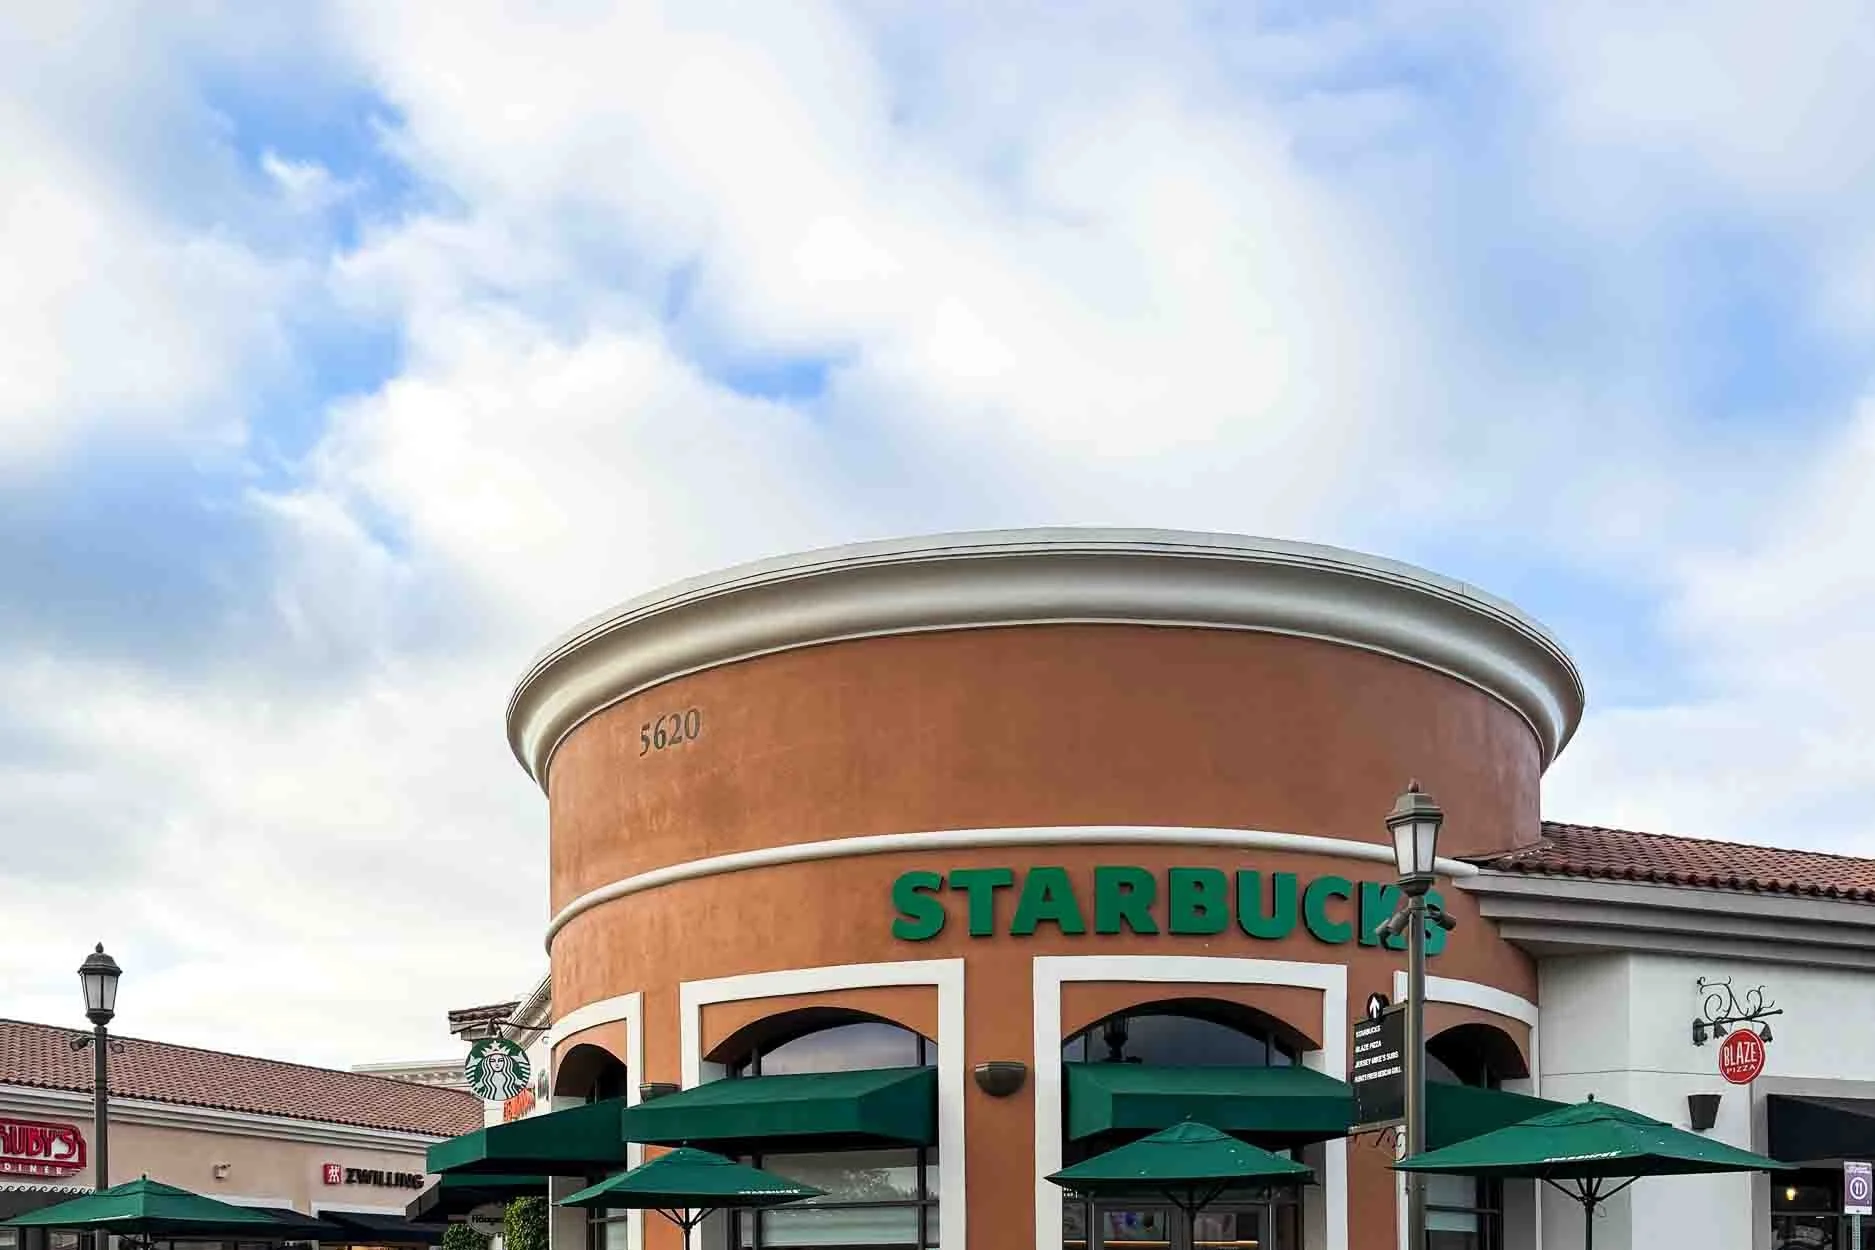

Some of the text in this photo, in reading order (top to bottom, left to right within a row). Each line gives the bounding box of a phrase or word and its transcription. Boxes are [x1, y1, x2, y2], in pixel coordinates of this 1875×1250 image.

[640, 708, 701, 757] 5620
[1724, 1041, 1757, 1066] BLAZE
[1726, 1064, 1756, 1074] PIZZA
[4, 1162, 62, 1175] DINER
[345, 1167, 424, 1189] ZWILLING
